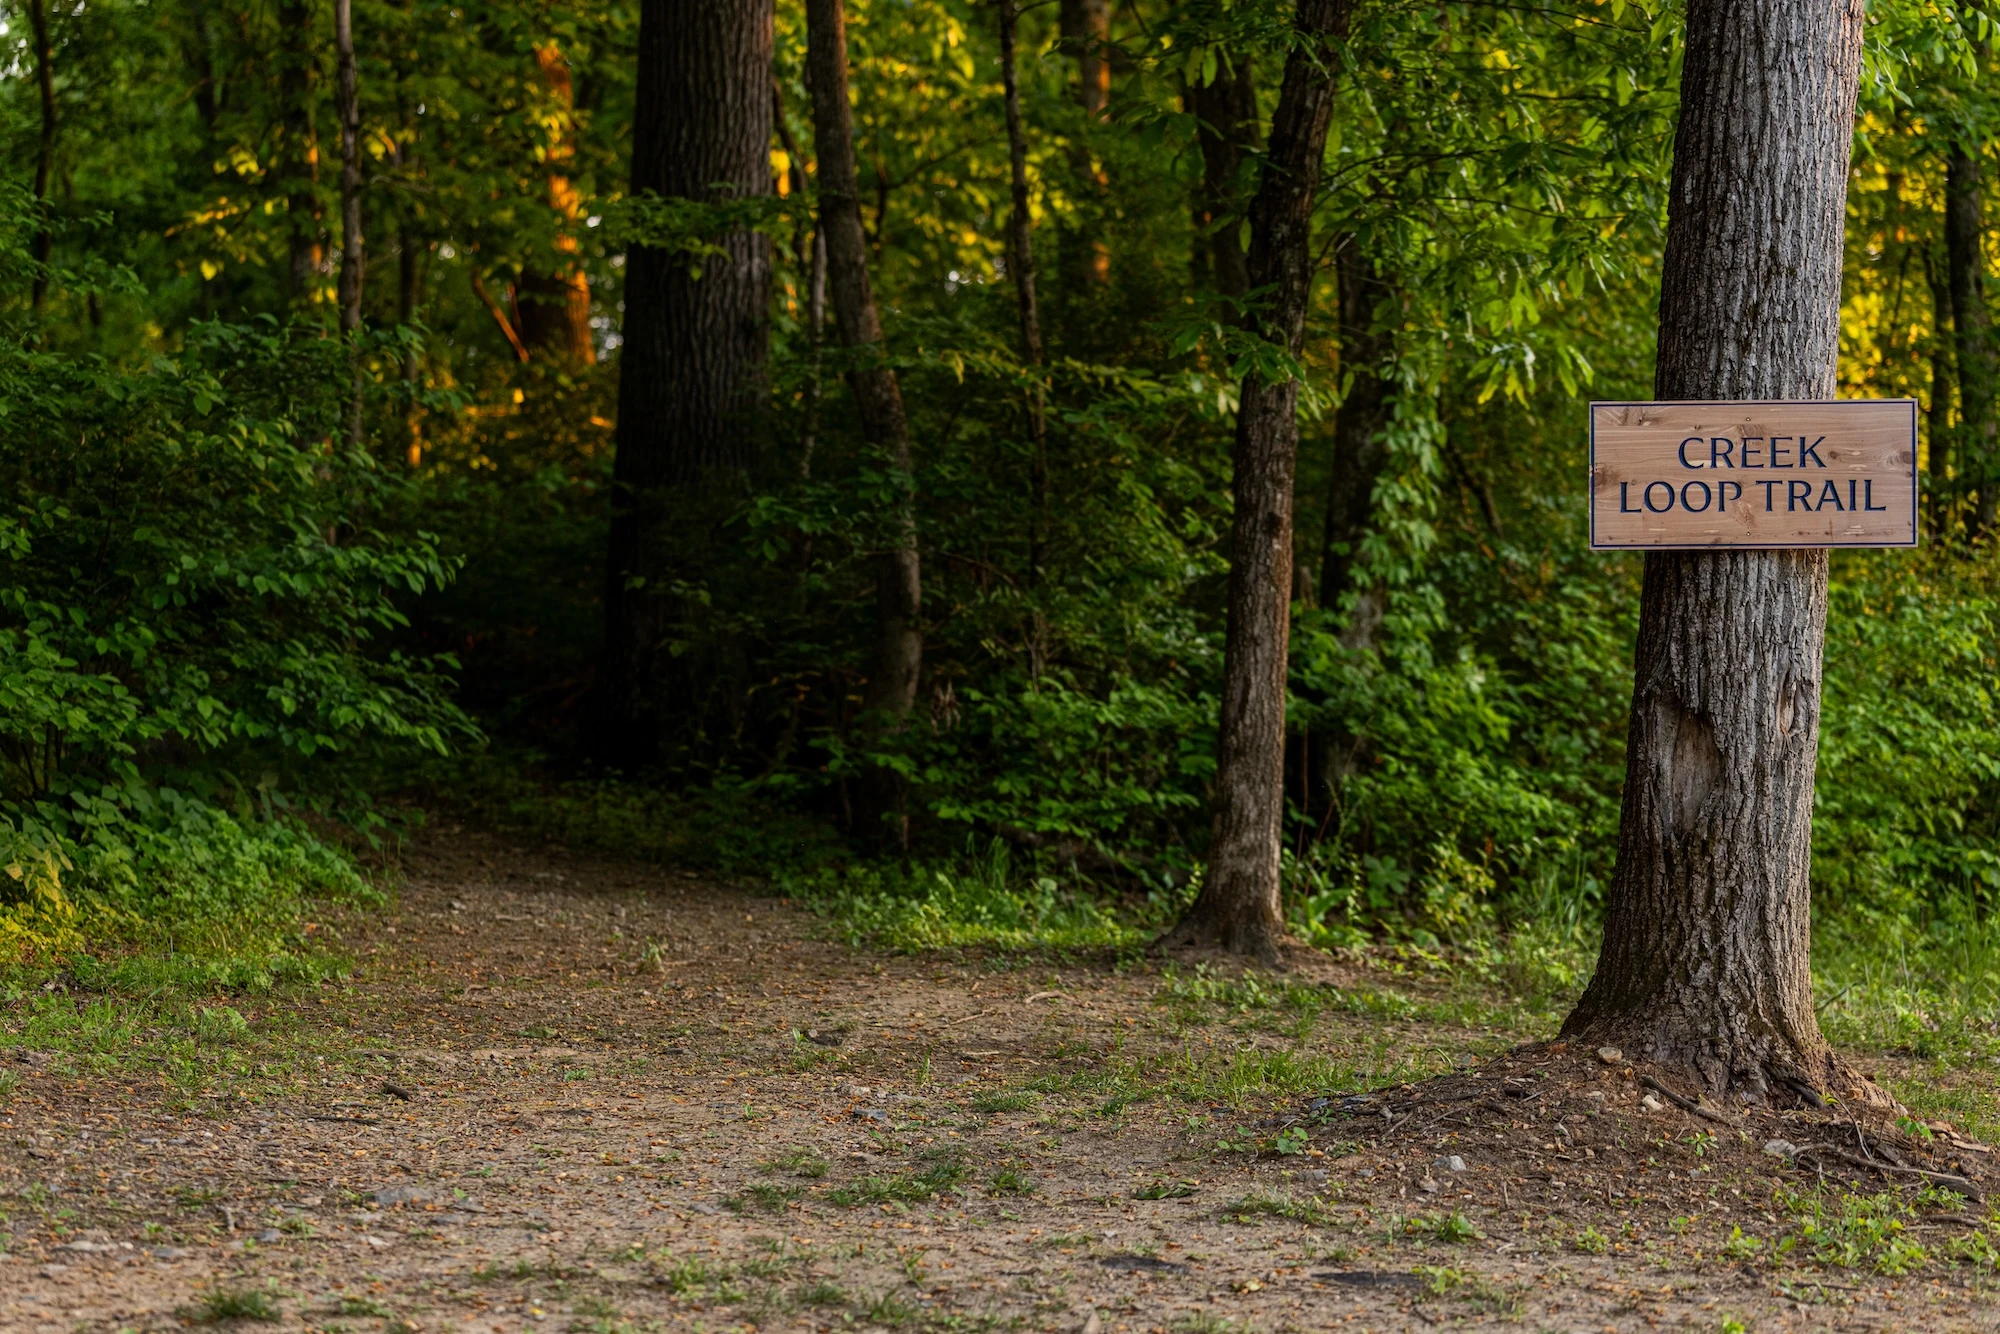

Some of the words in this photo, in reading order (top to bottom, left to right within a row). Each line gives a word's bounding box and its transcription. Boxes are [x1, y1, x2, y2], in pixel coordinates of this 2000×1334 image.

[1678, 436, 1827, 469] CREEK
[1619, 480, 1742, 513] LOOP
[1755, 479, 1887, 512] TRAIL
